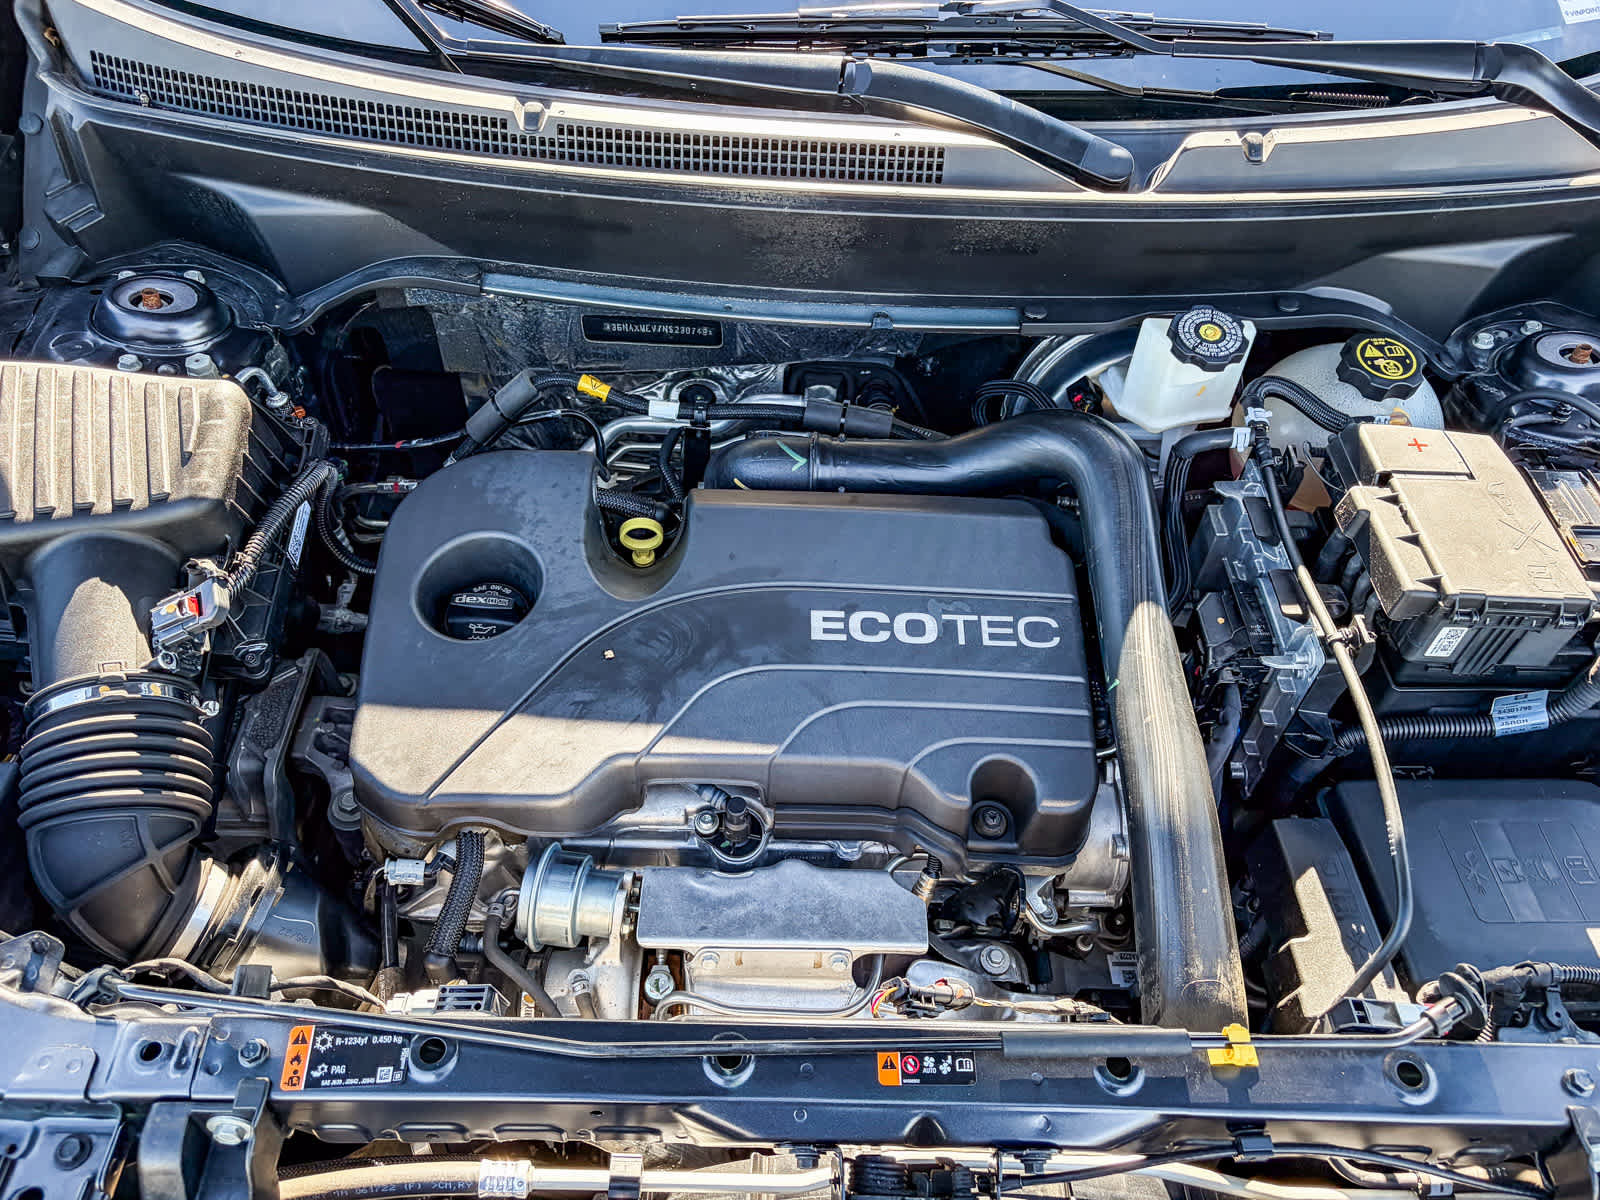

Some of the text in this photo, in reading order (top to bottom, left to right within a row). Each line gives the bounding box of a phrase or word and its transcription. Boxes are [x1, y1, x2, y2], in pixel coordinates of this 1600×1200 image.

[810, 609, 1061, 648] ECOTEC
[372, 1035, 392, 1045] 0.450
[393, 1034, 403, 1045] kg
[331, 1065, 346, 1075] PAG
